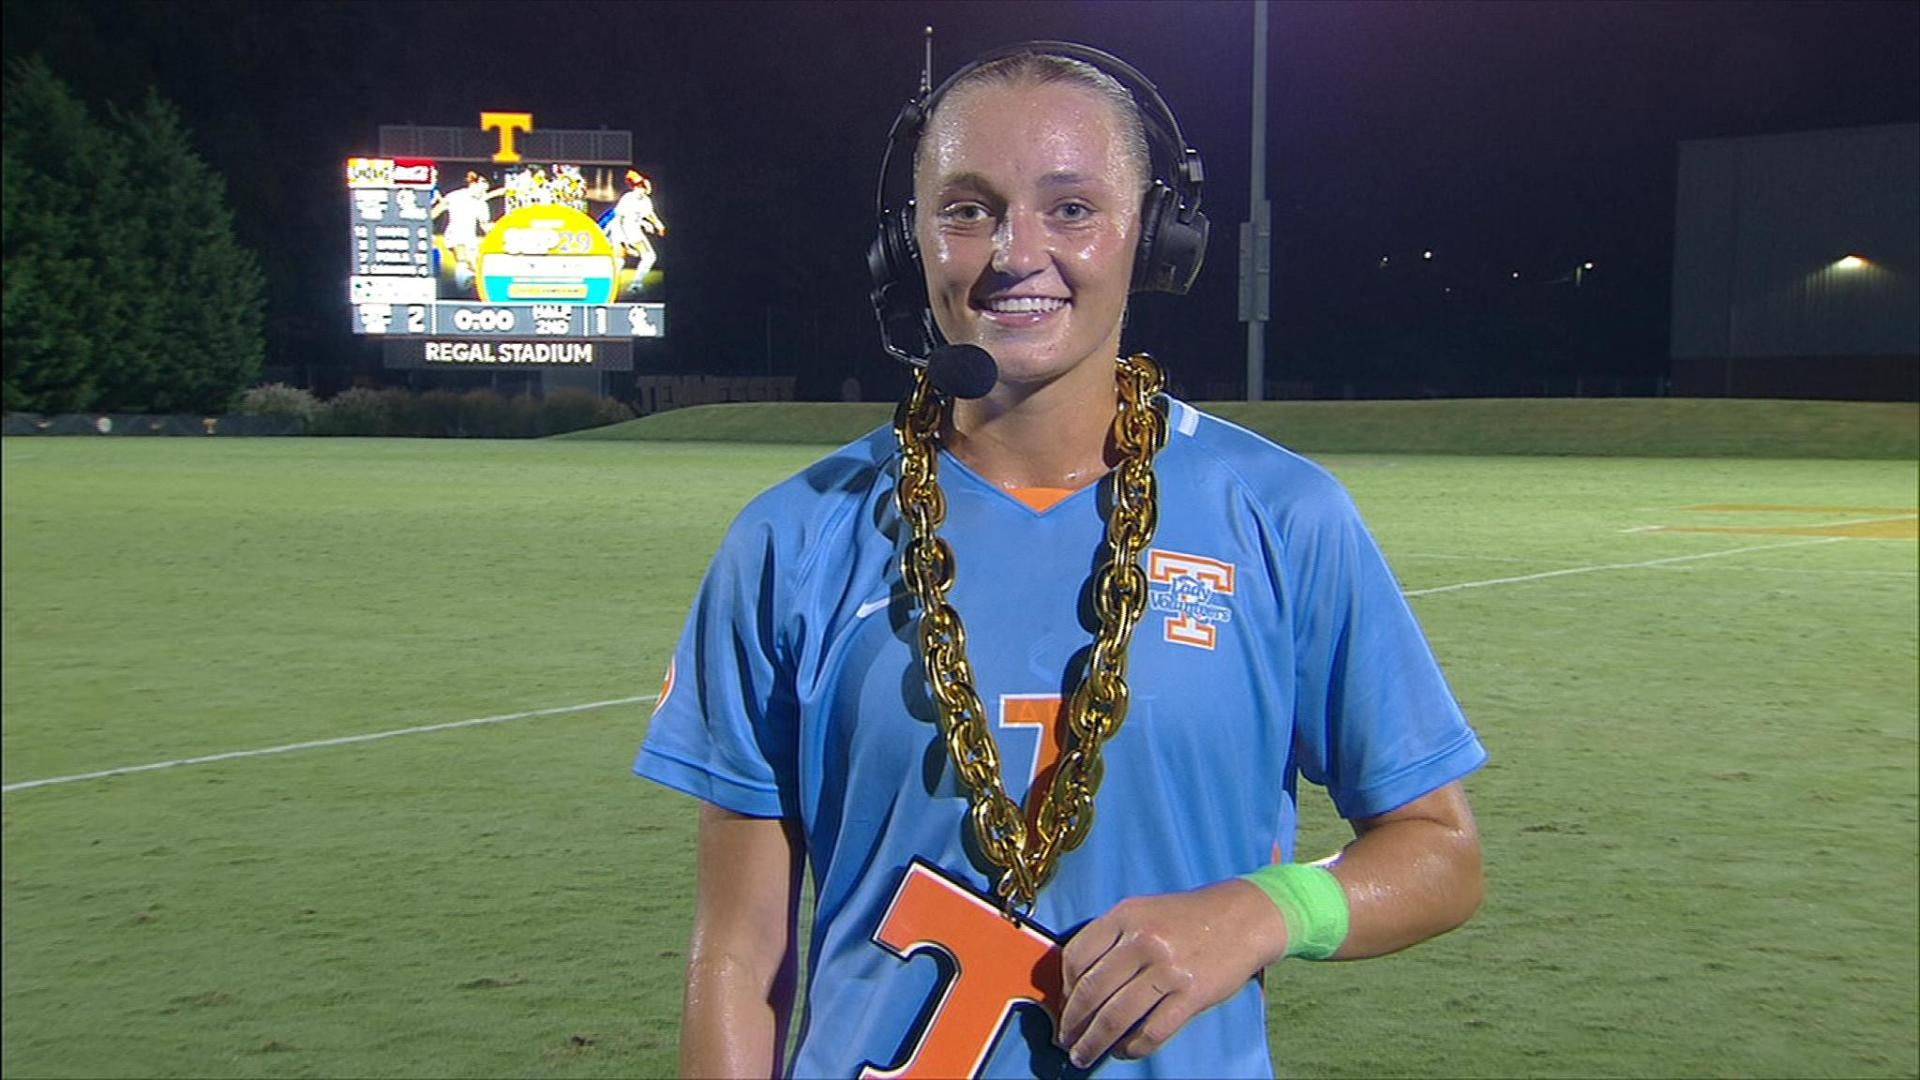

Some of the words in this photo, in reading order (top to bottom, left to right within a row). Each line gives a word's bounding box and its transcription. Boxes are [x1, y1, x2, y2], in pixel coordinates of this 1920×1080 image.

[480, 112, 533, 162] T
[408, 305, 425, 333] 2
[454, 309, 514, 331] 0:00
[595, 307, 607, 334] 1
[425, 343, 496, 363] REGAL
[499, 343, 592, 363] STADIUM
[1148, 549, 1236, 650] T
[1172, 577, 1213, 604] Lady
[858, 856, 1066, 1080] T
